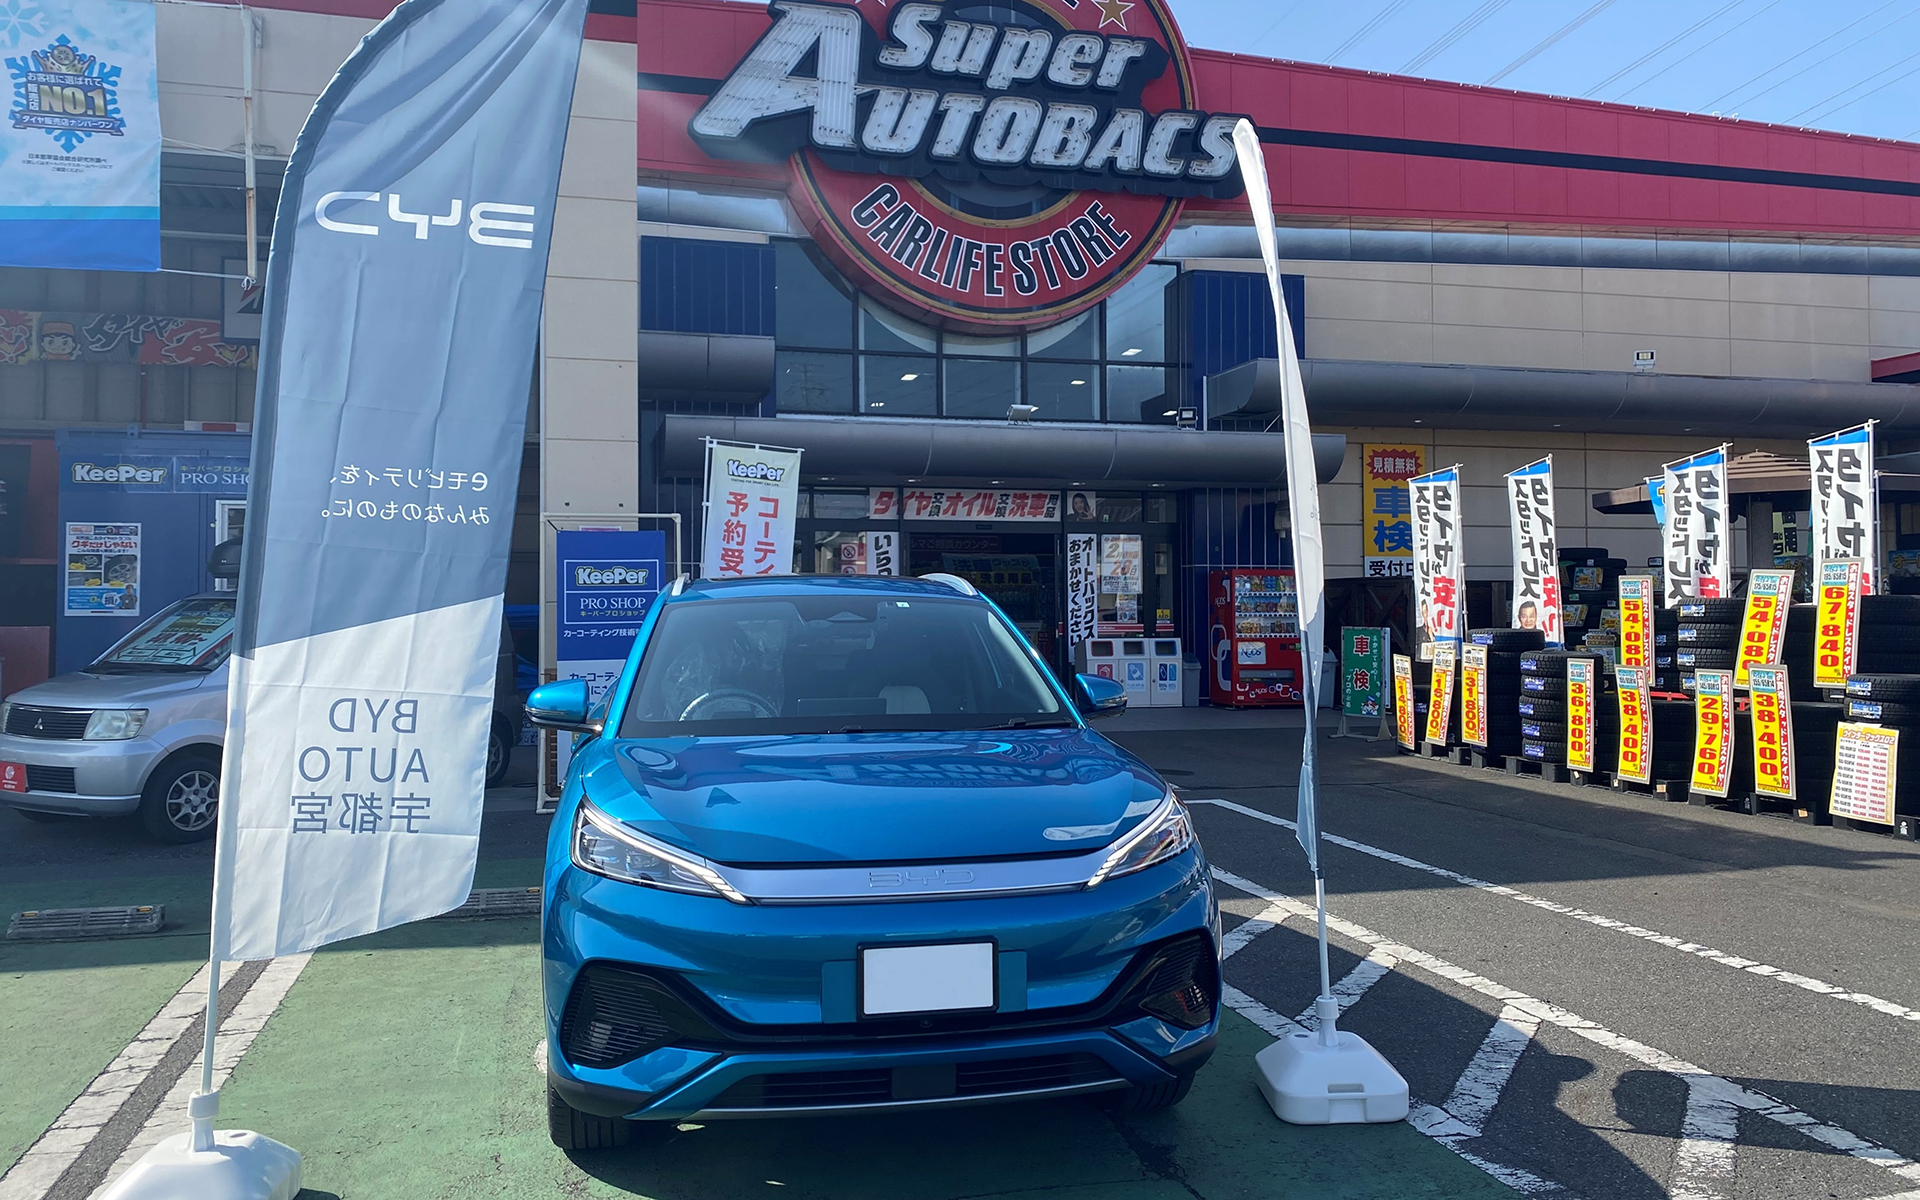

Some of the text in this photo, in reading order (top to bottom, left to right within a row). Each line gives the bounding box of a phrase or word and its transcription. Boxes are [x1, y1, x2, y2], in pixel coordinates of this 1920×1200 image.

[878, 2, 1149, 91] Super
[27, 72, 103, 87] お客様に選ばれて
[692, 0, 1240, 180] AUTOBACS
[40, 84, 106, 116] NO.1
[22, 116, 114, 129] タイヤ販売店ナンバーワン
[851, 182, 1132, 297] CARLIFE STORE
[72, 463, 167, 484] KeePer
[727, 459, 785, 482] KeePer
[1373, 457, 1417, 474] 見積無料
[181, 473, 250, 485] PRO SH
[1373, 486, 1413, 553] 車検
[575, 566, 649, 586] KeePer
[1069, 539, 1083, 648] おまかせください
[1081, 535, 1095, 640] オートバックス
[580, 597, 646, 609] PRO SHOP
[869, 869, 976, 888] BYD
